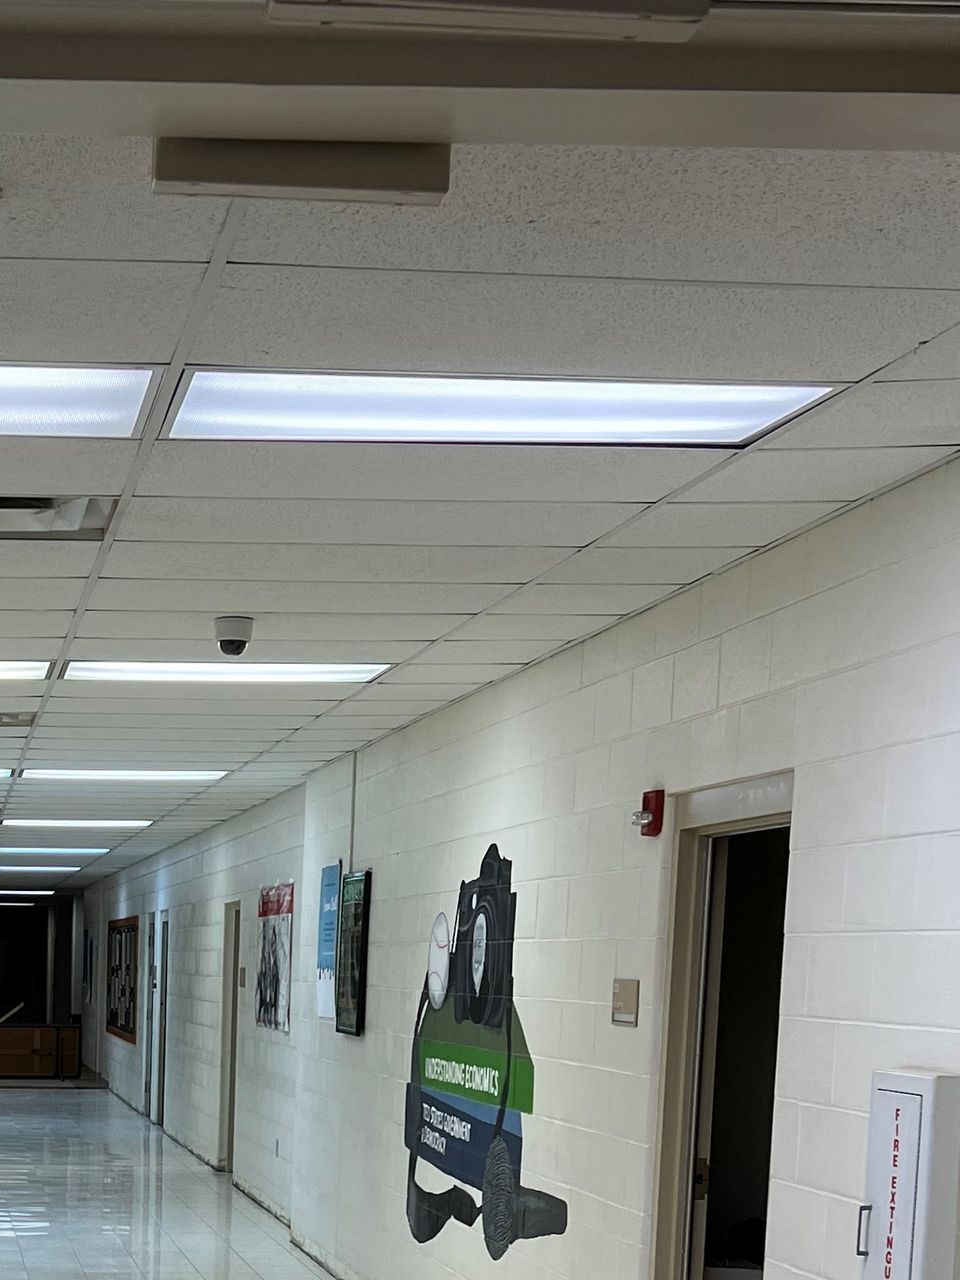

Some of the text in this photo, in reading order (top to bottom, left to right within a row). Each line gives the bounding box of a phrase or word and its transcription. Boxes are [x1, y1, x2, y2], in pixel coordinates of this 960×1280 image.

[425, 1057, 499, 1096] UNDERSTANDING ECONOMICS
[892, 1108, 901, 1168] FIRE
